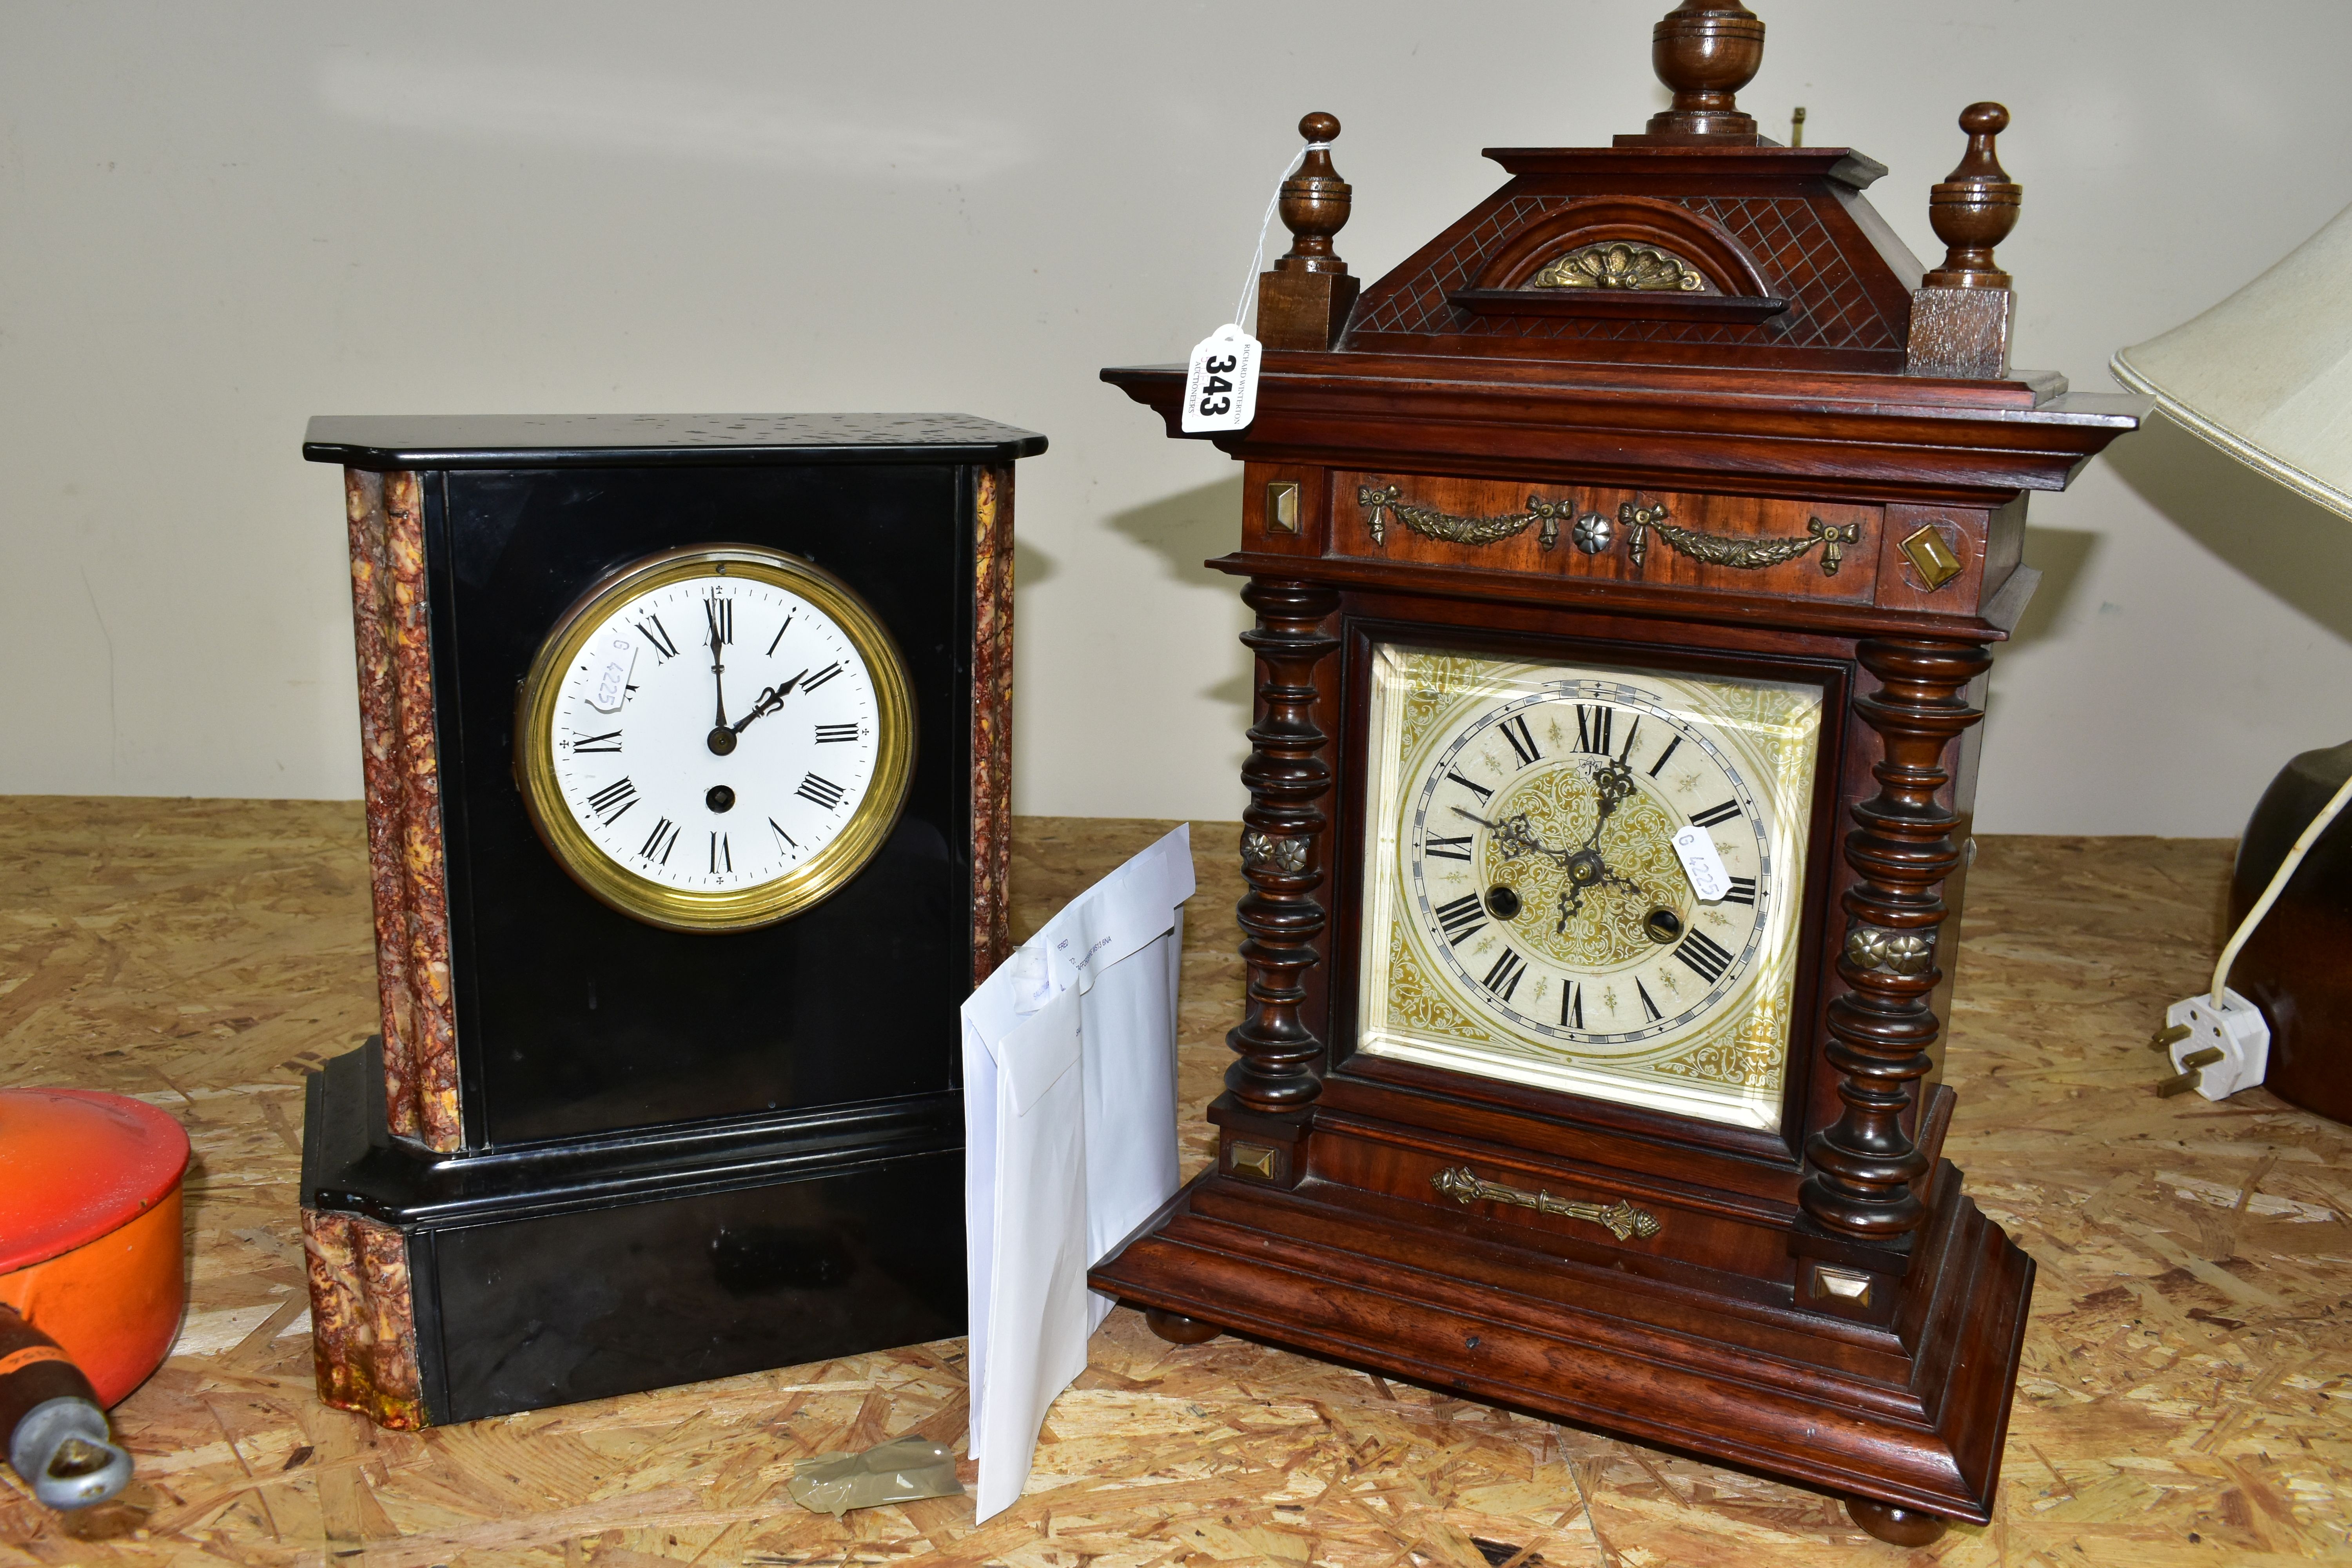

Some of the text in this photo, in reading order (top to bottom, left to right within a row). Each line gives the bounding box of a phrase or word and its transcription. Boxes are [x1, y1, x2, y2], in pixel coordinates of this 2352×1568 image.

[1189, 361, 1201, 413] AUCTIONEERS
[1200, 355, 1237, 416] 343
[1234, 344, 1250, 425] RICHARD WINTERTON
[634, 613, 681, 666] XI
[599, 640, 630, 705] G 4225
[799, 660, 844, 695] II
[573, 729, 622, 754] IX
[815, 722, 859, 745] III
[1495, 713, 1544, 771] XI
[1570, 704, 1612, 757] XII
[586, 775, 641, 827] VIII
[794, 771, 846, 811] IIII
[1446, 762, 1494, 808] X
[769, 817, 799, 856] V
[1687, 796, 1744, 829] II
[638, 815, 682, 866] VII
[710, 831, 733, 874] VI
[1425, 827, 1474, 864] IX
[1679, 835, 1719, 895] G 4225
[1102, 936, 1112, 946] 6NA
[1433, 888, 1489, 950] VIII
[1057, 939, 1069, 951] ERED
[1672, 924, 1735, 987] IIII
[1480, 945, 1528, 1004] VII
[1635, 975, 1665, 1024] V
[1561, 978, 1586, 1030] VI
